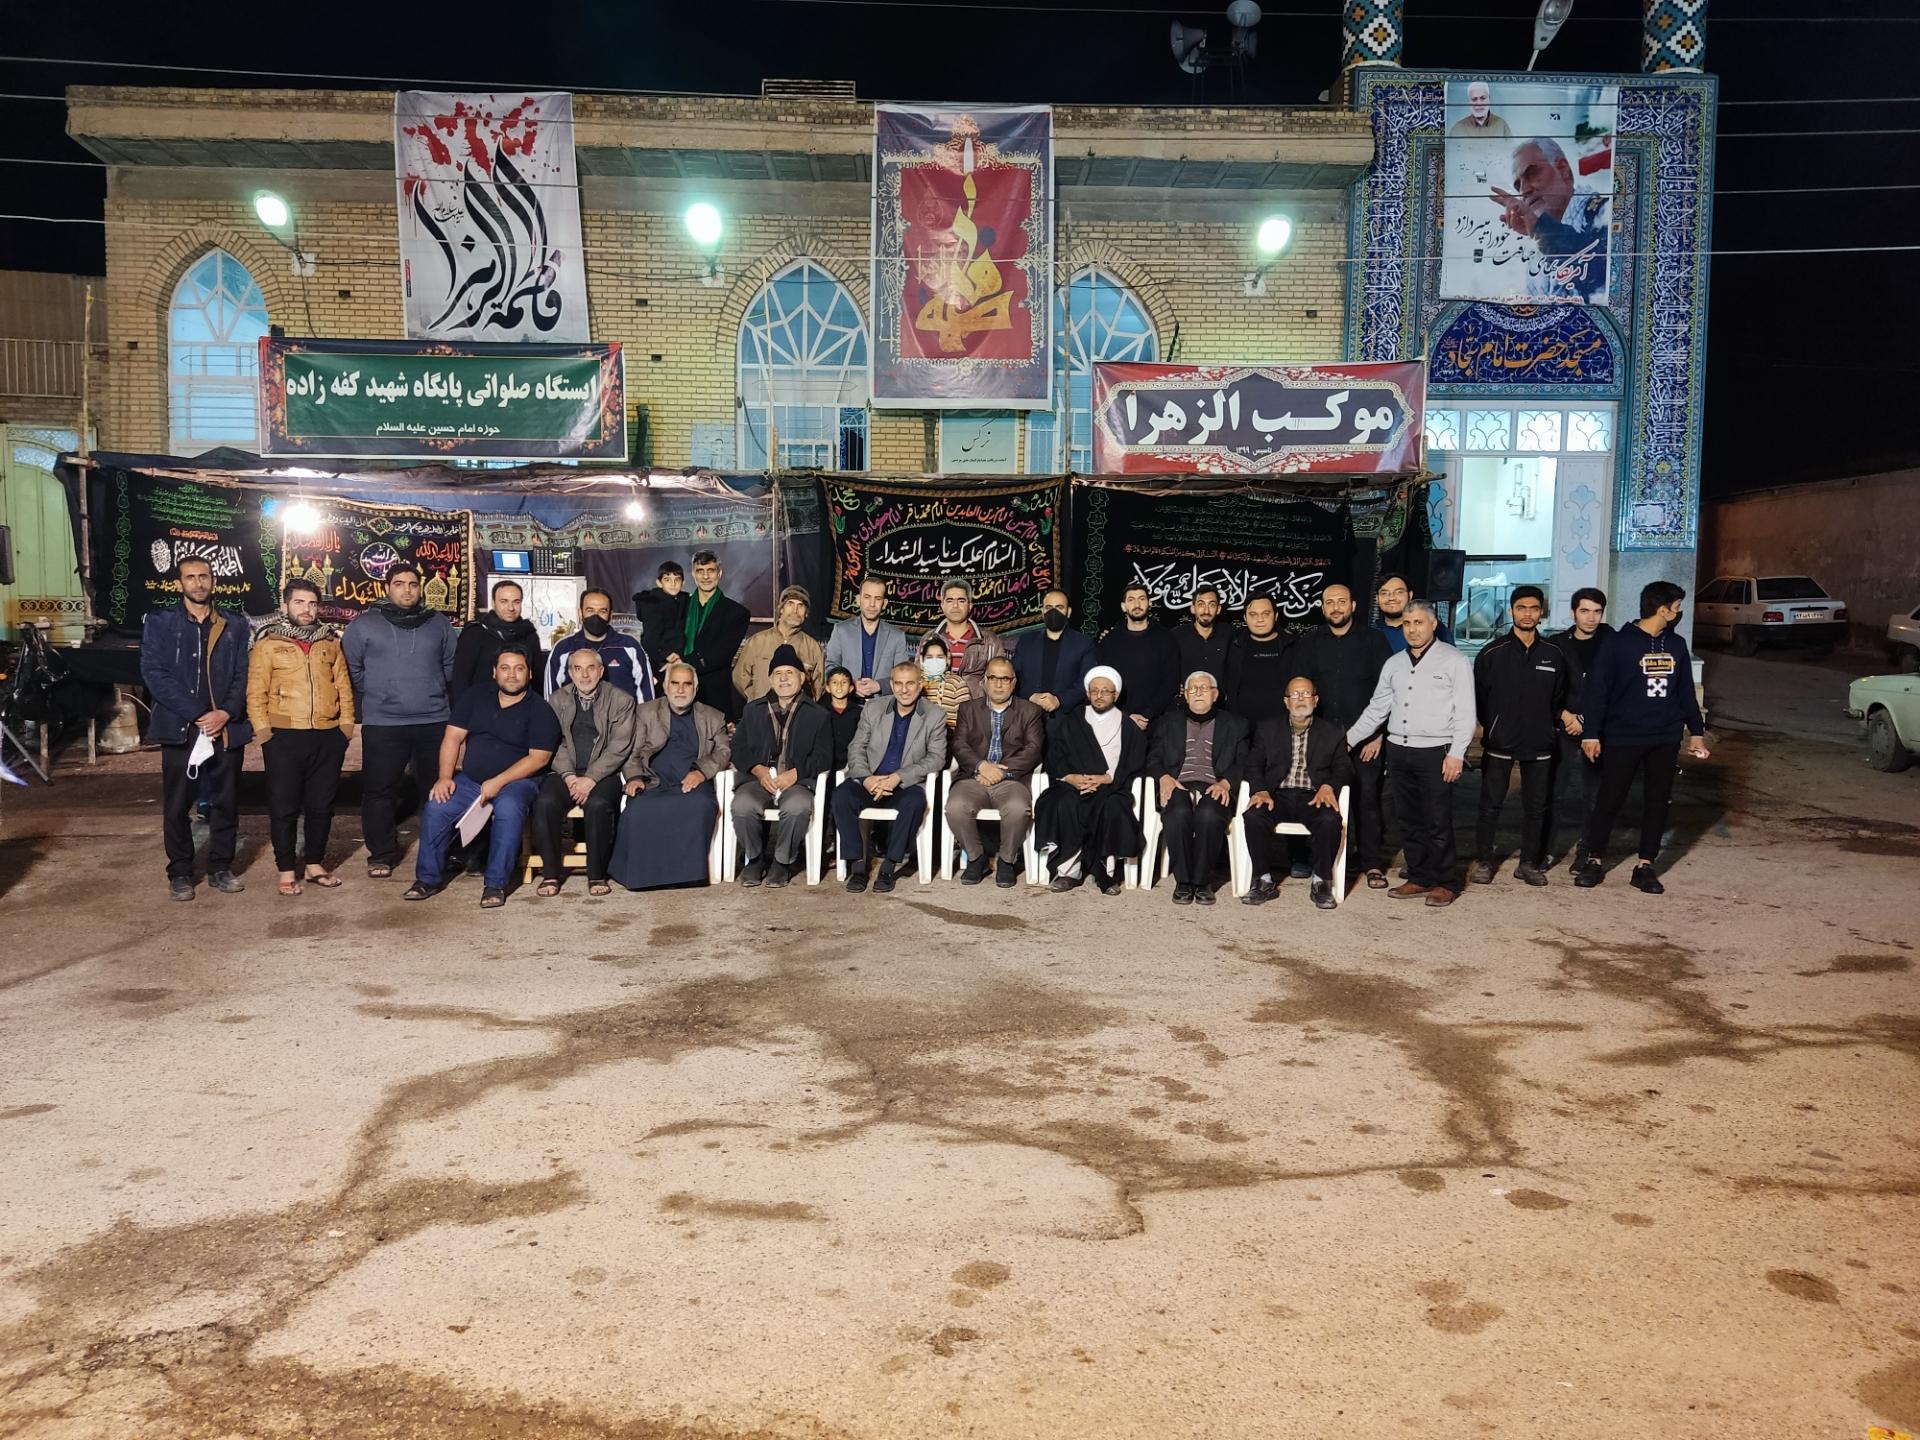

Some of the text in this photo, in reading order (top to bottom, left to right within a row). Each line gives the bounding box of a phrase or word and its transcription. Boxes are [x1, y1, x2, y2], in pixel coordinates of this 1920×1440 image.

[1475, 333, 1510, 380] امام
[1504, 336, 1568, 376] حضرت
[1556, 329, 1601, 377] مسجد
[286, 369, 598, 408] ایستگاه صلواتی پایگاه شهید کفه زاده
[376, 422, 501, 436] حوزه امام حسین علیه السلام
[1126, 390, 1394, 445] موکب الزهرا
[938, 534, 984, 573] علیک
[982, 540, 1016, 571] السلام
